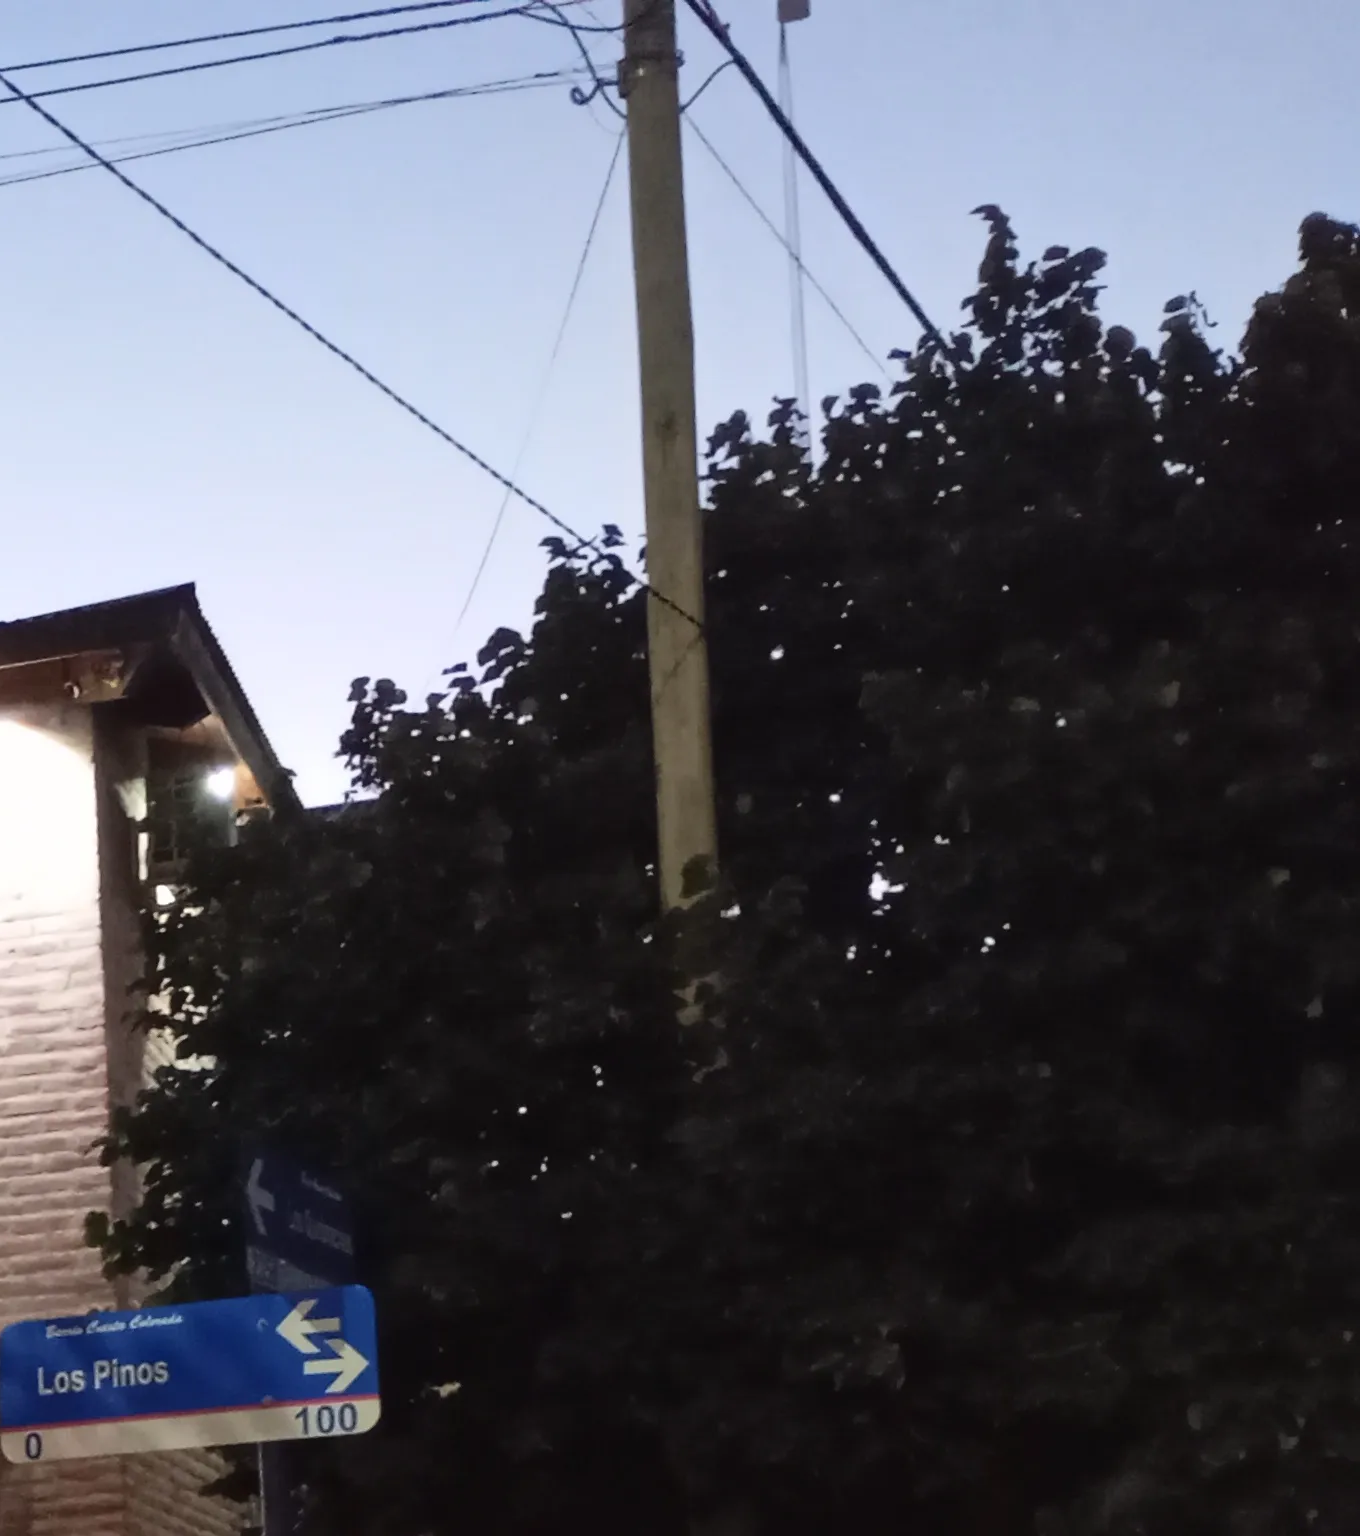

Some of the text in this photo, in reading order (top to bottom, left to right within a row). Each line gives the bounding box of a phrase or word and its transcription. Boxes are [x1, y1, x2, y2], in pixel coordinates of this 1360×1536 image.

[37, 1360, 169, 1396] Los Pinos
[294, 1402, 358, 1436] 100
[25, 1432, 42, 1460] 0
